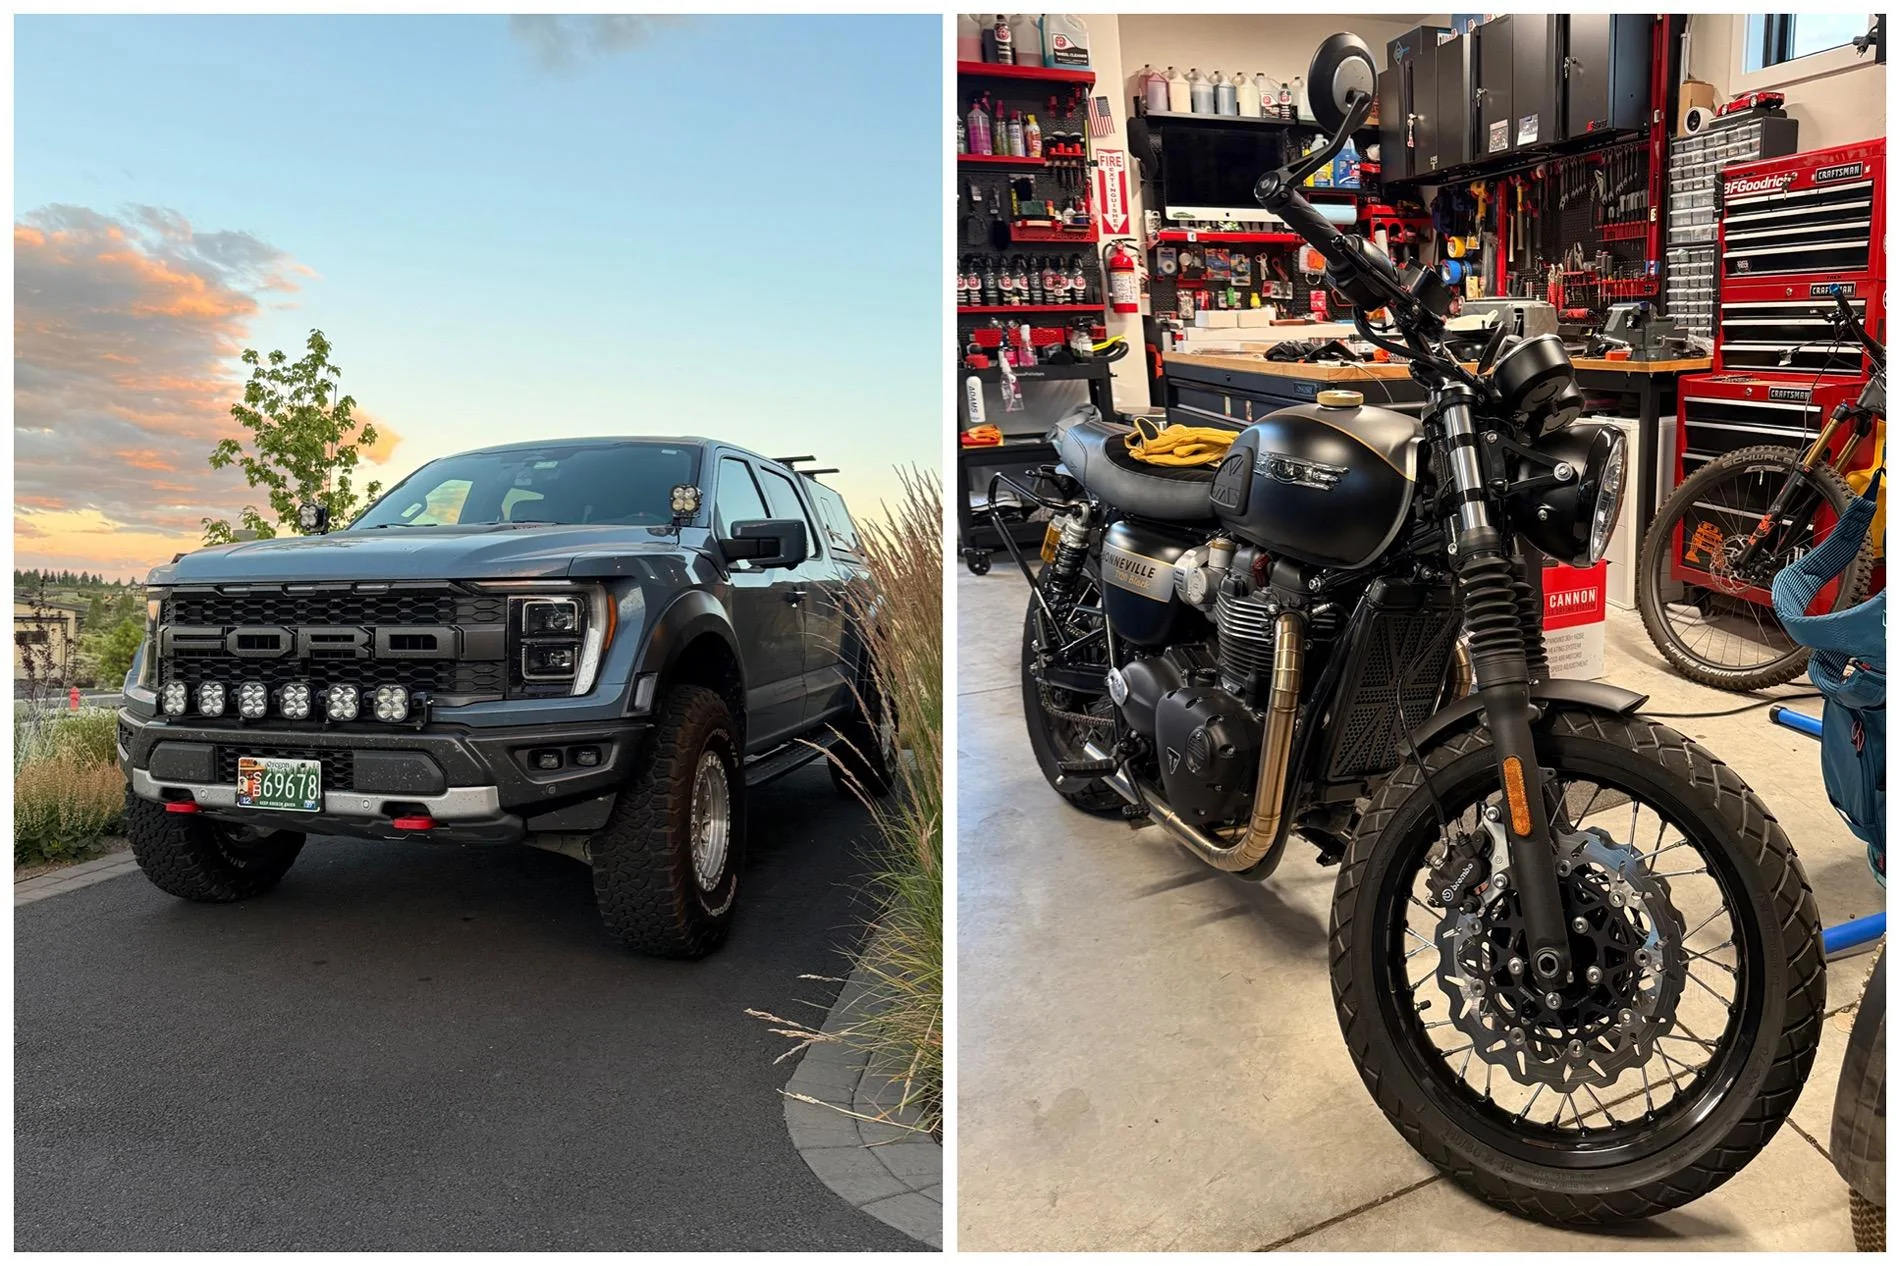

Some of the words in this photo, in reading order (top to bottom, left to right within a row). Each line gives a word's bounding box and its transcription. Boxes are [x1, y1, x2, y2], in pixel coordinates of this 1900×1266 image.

[1100, 156, 1122, 167] FIRE
[1818, 165, 1860, 180] CRAFTSMAN
[1108, 168, 1119, 228] EXTINGUISHER
[1812, 285, 1853, 294] CRAFAN
[968, 386, 978, 413] ADAMS
[1771, 390, 1810, 399] CRAFTSMAN
[1722, 454, 1793, 469] SCHWALB
[1549, 589, 1596, 608] CANNON
[160, 625, 457, 660] FORD
[263, 772, 317, 799] 69678
[1450, 863, 1474, 891] brembo
